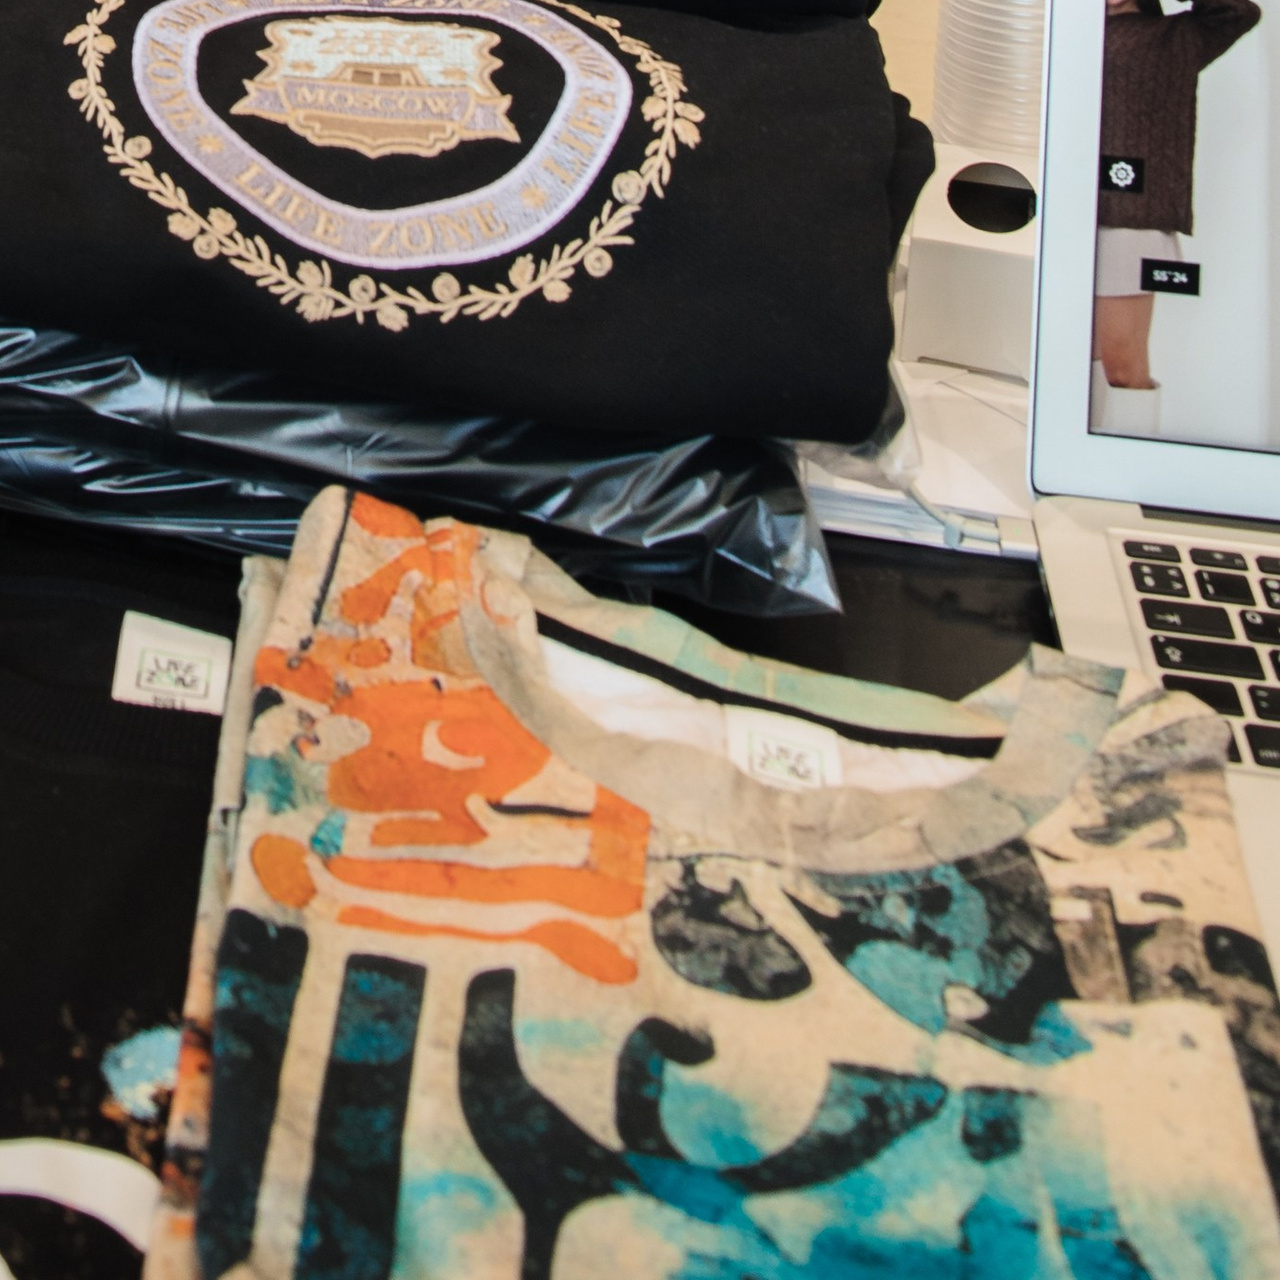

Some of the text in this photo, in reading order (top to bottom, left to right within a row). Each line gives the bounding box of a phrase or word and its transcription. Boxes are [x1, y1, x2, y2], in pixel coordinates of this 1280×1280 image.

[296, 86, 456, 114] MOSCOW
[234, 161, 508, 256] LIFE ZONE
